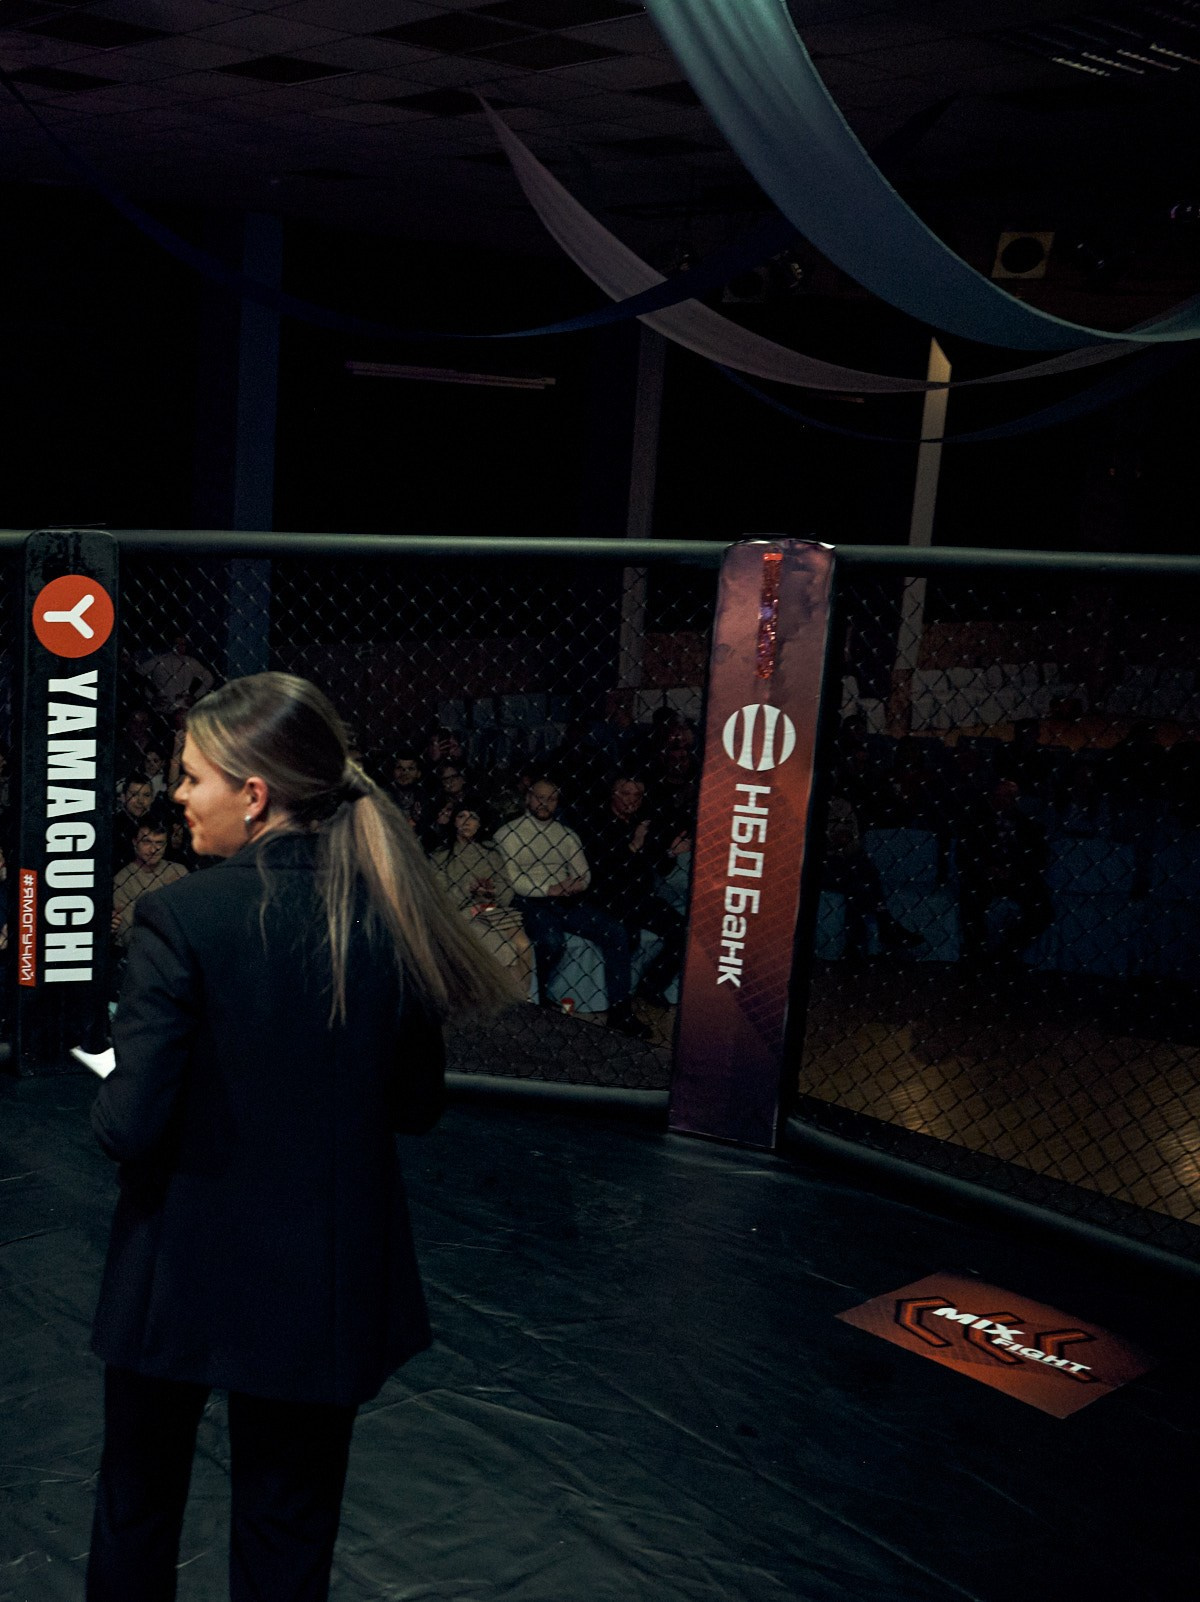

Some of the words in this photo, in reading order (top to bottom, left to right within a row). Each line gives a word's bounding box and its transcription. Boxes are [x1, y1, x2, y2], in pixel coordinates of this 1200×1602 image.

[44, 669, 99, 983] YAMAGUCHI
[726, 783, 772, 879] НБД
[21, 873, 35, 981] #ЯМОГУЧИЙ
[716, 885, 761, 989] Банк
[932, 1307, 1026, 1341] MIX
[991, 1337, 1092, 1374] FIGHT
